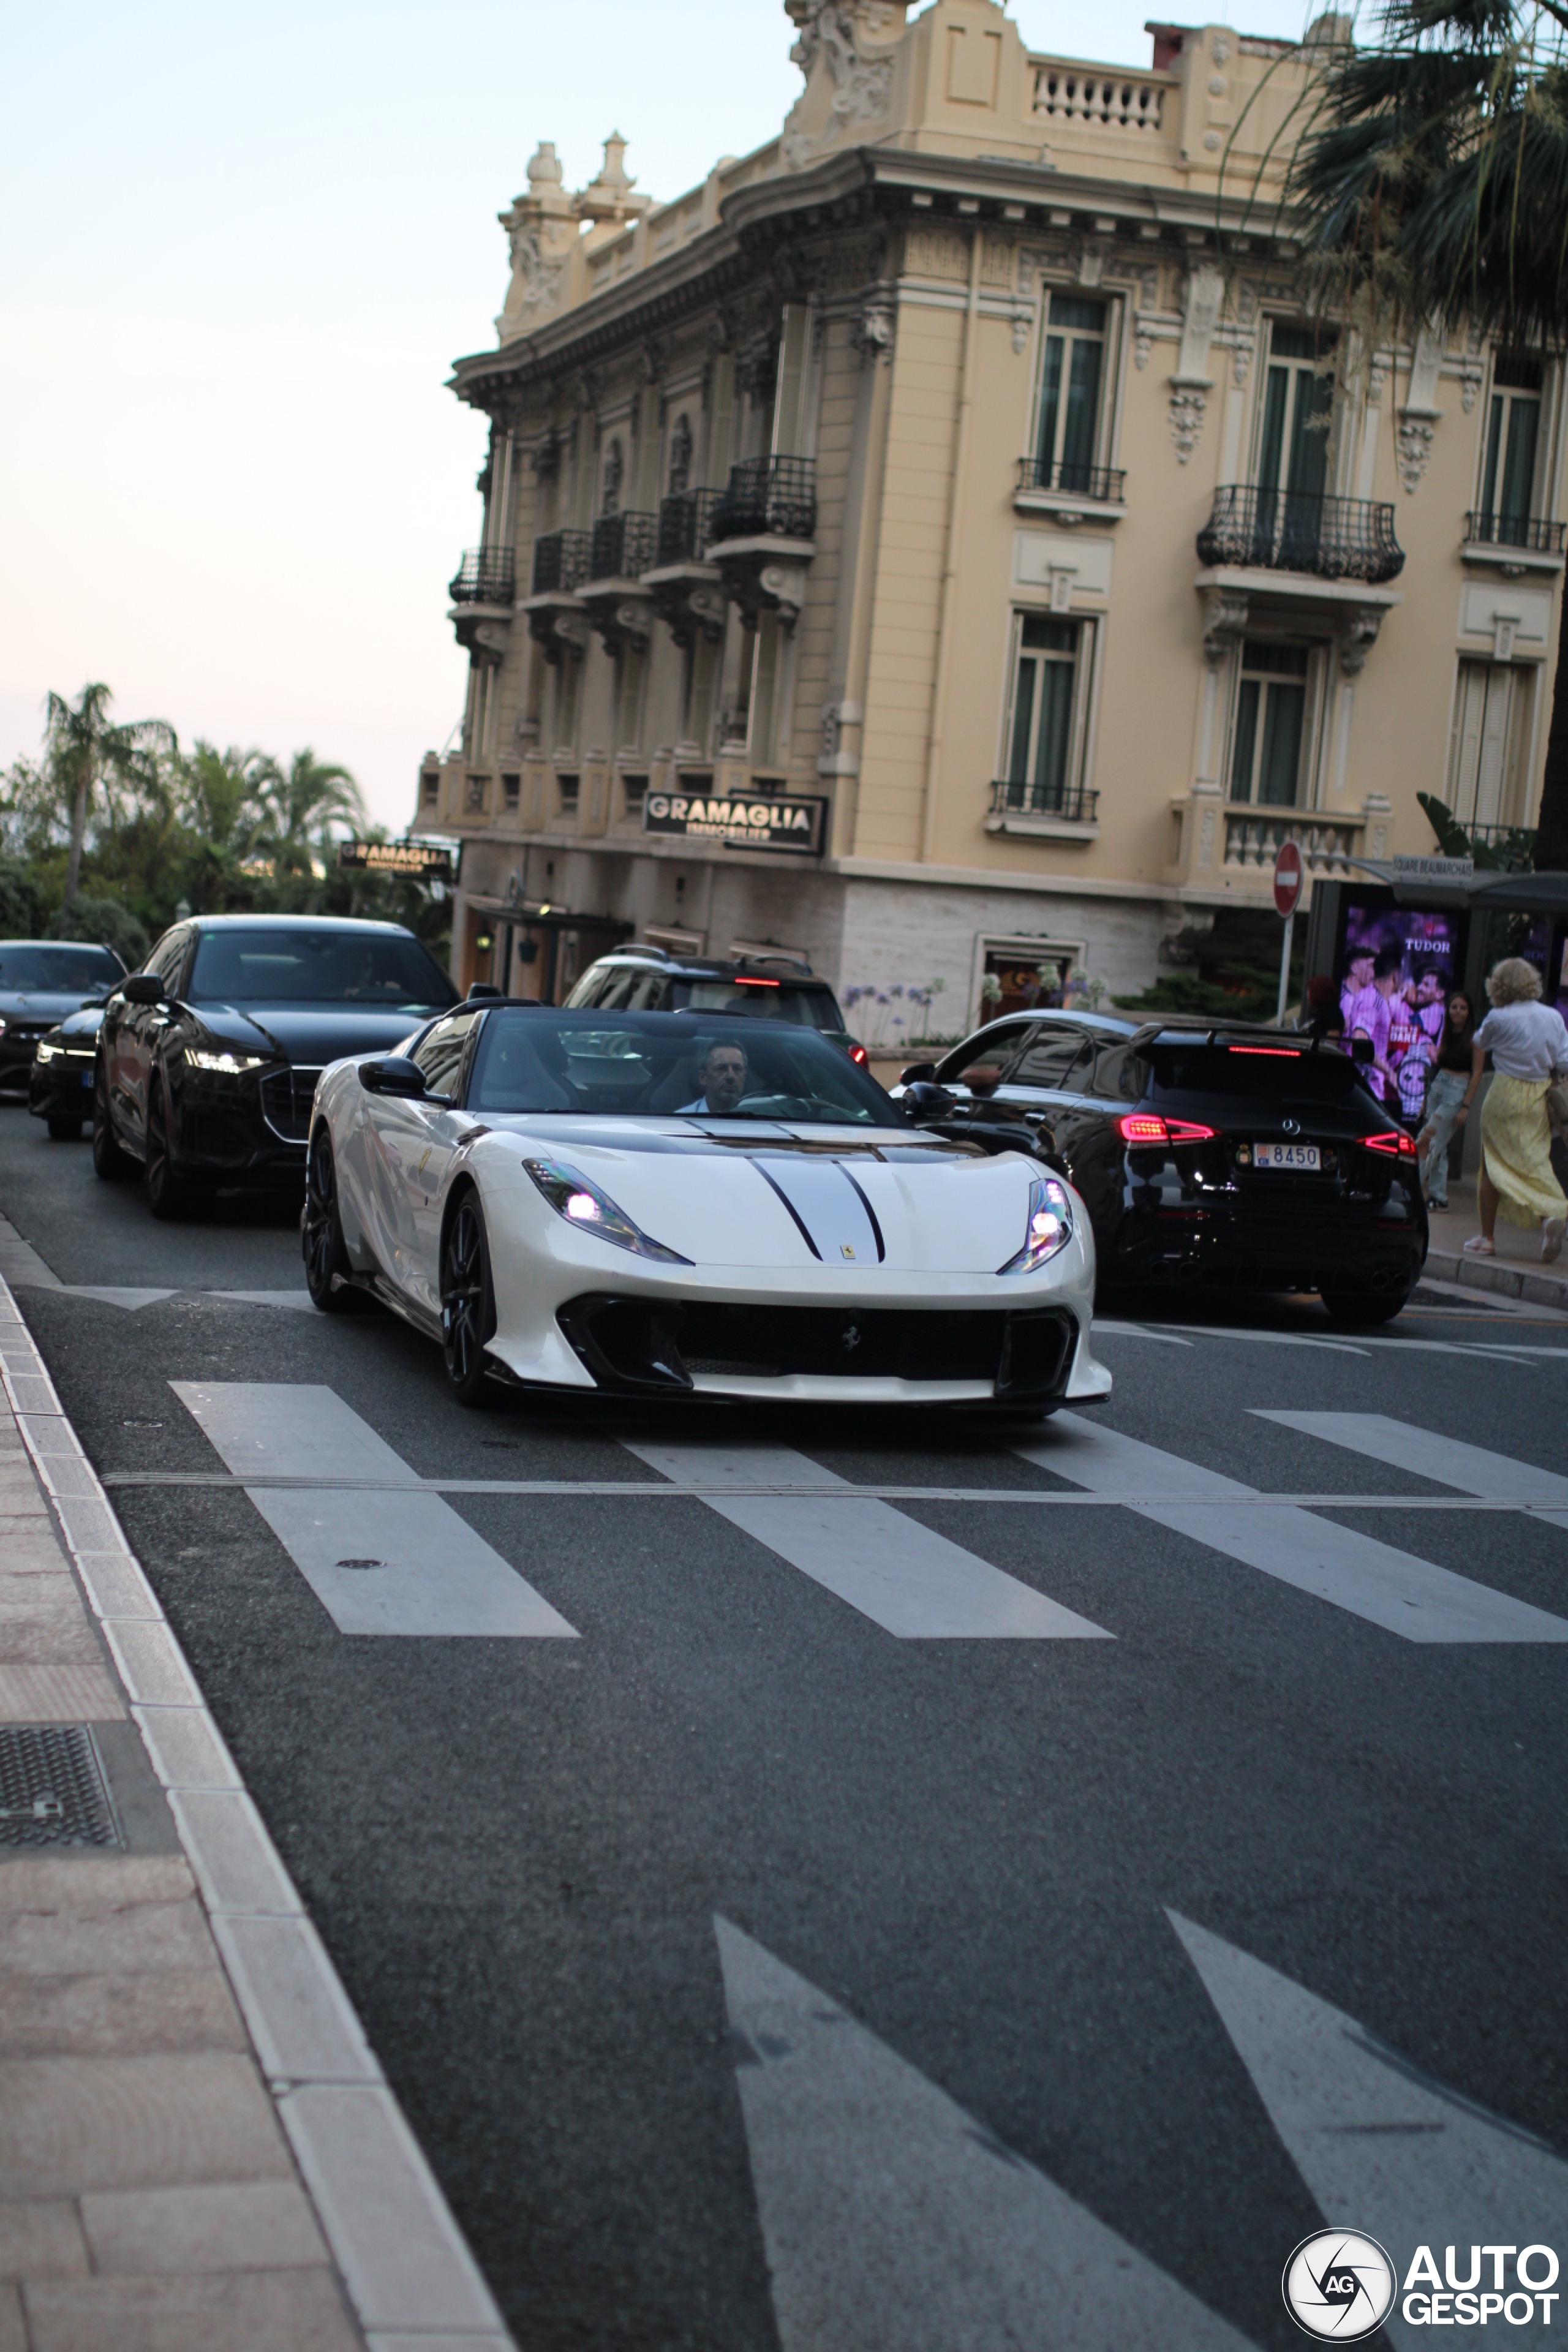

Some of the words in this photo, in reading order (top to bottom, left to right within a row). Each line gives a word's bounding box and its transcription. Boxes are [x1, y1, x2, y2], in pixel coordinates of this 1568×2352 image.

[649, 796, 810, 831] GRAMAGLIA
[685, 823, 771, 841] IMMOBILIER
[1393, 858, 1419, 873] SQUARE
[1420, 859, 1472, 878] BEAUMARCHAIS
[1405, 938, 1450, 954] TUDOR
[1274, 1146, 1316, 1165] 8450
